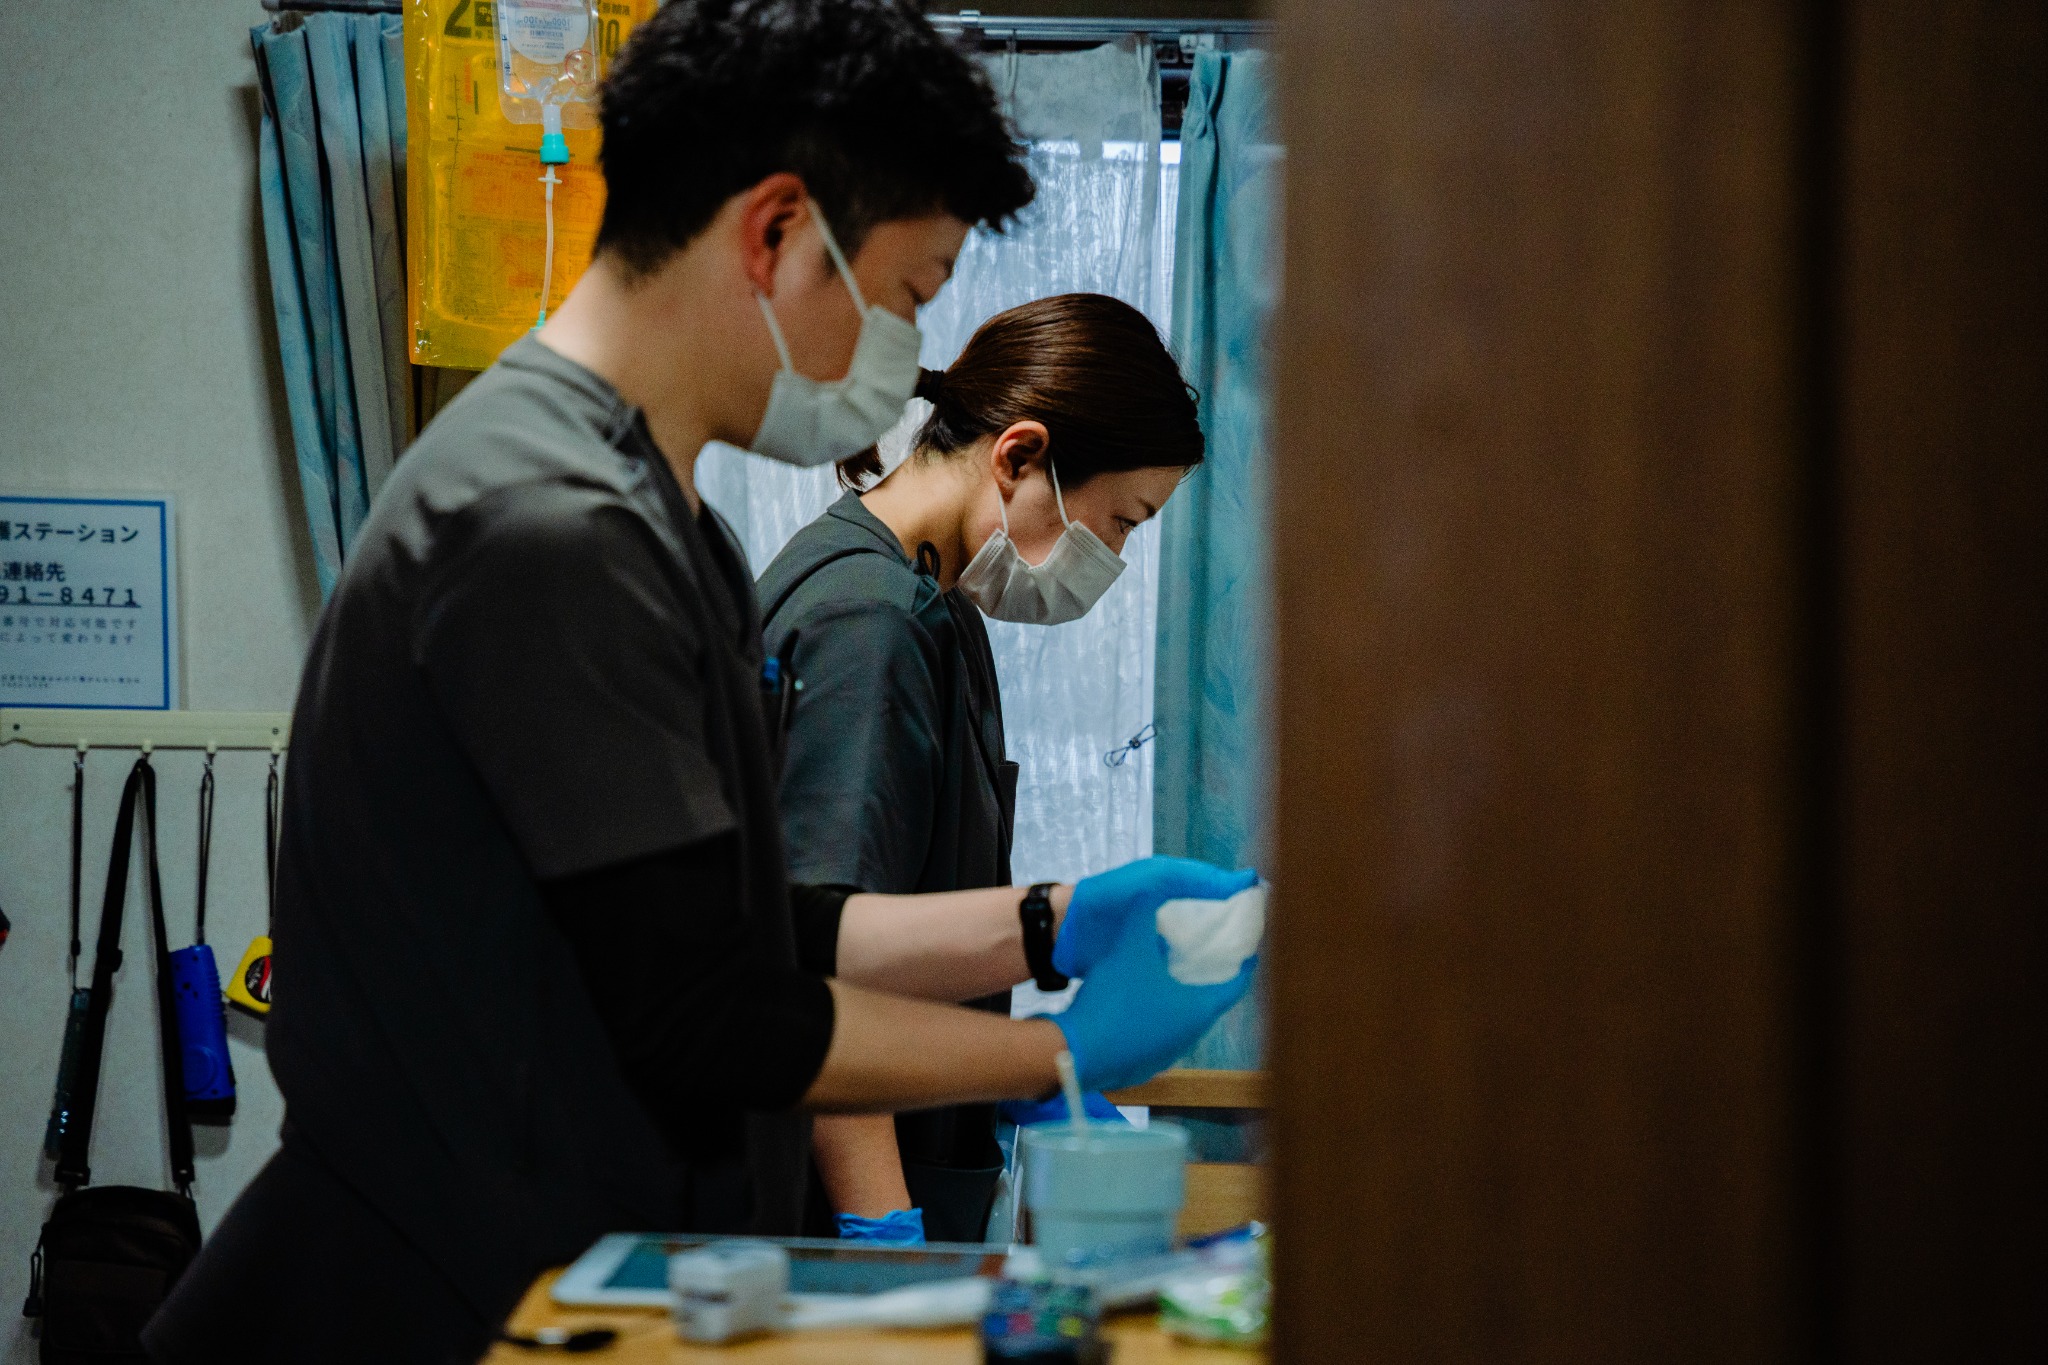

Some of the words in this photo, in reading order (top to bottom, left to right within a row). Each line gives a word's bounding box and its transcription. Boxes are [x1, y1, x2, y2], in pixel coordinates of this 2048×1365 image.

[0, 561, 66, 582] 連絡先
[0, 585, 138, 607] 91-8471
